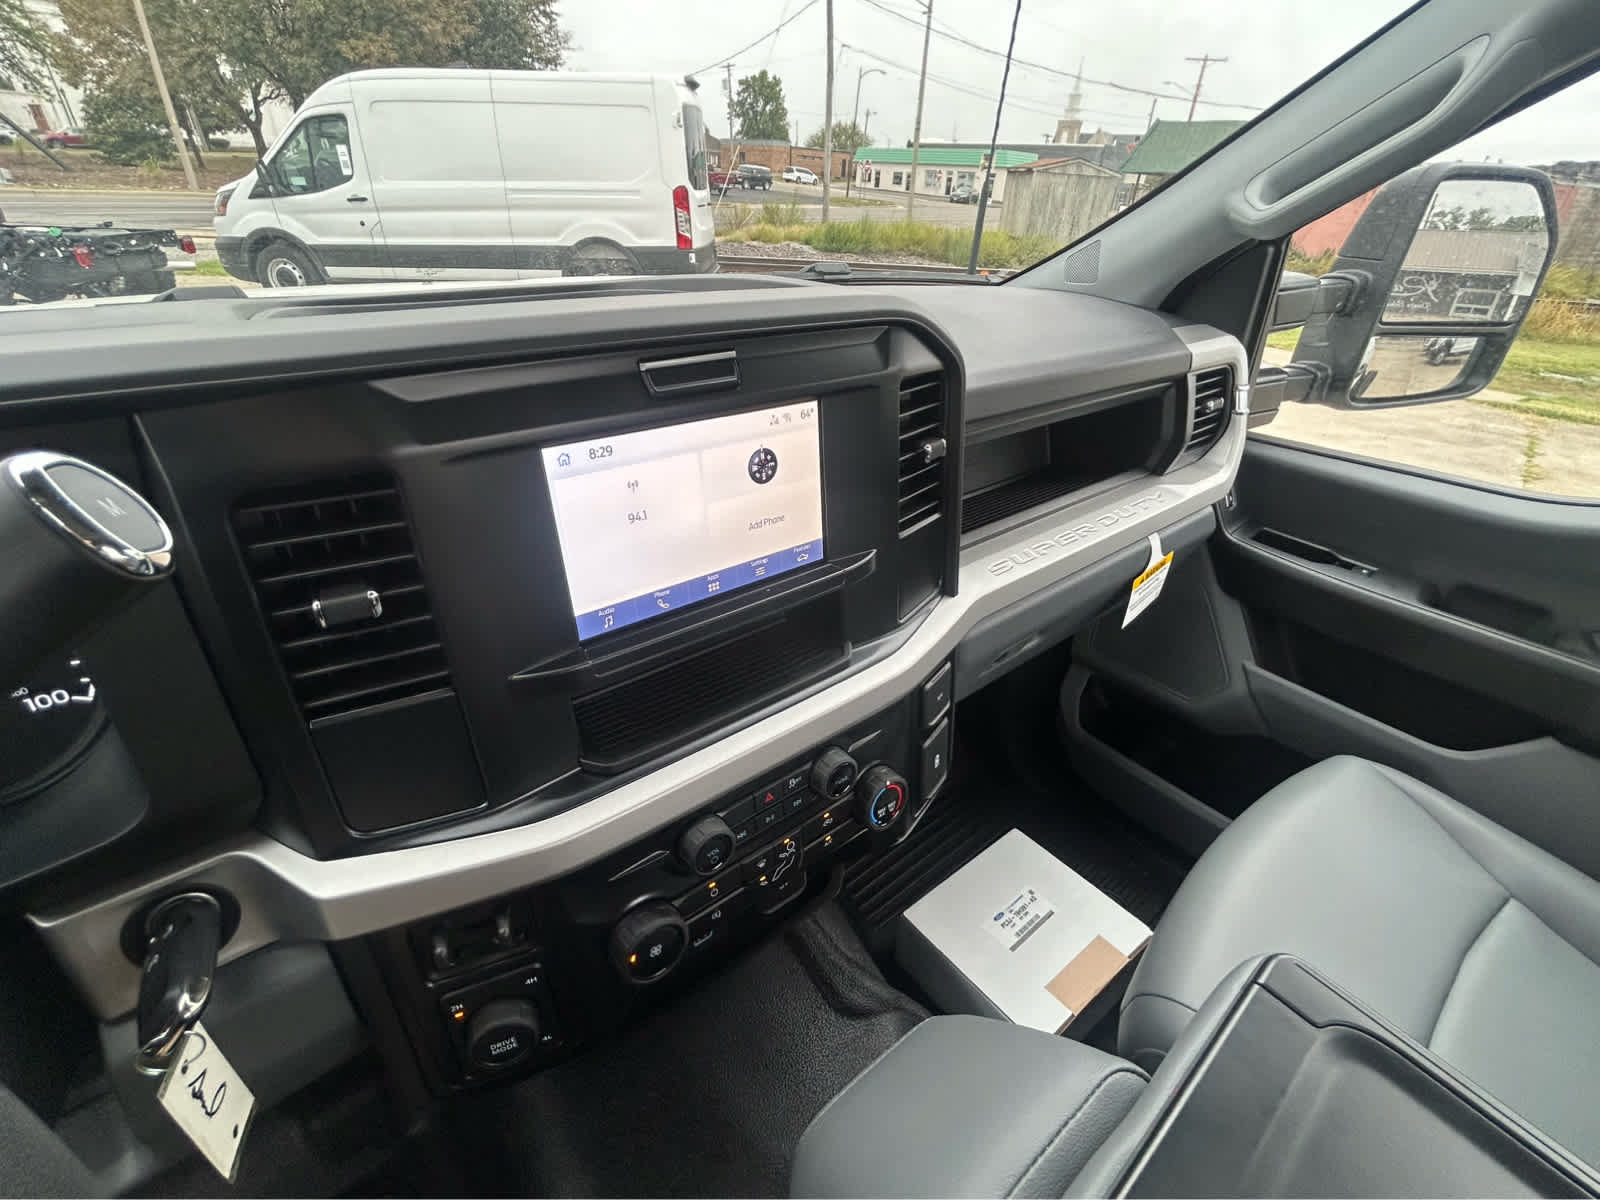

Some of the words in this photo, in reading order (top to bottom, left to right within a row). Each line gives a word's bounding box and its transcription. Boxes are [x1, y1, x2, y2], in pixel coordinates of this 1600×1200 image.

[588, 445, 613, 460] 8:29
[627, 510, 648, 524] 94.1
[748, 519, 763, 531] Add
[763, 515, 785, 529] Phone
[986, 522, 1098, 577] SUPER
[1096, 491, 1167, 528] DUTY
[707, 573, 719, 582] Apps
[654, 589, 671, 598] Phone
[598, 607, 615, 616] Audio
[22, 689, 71, 713] 100
[525, 976, 538, 985] 4H
[451, 1004, 464, 1012] 2H
[490, 1036, 516, 1050] DRIVE
[492, 1041, 518, 1055] MODE
